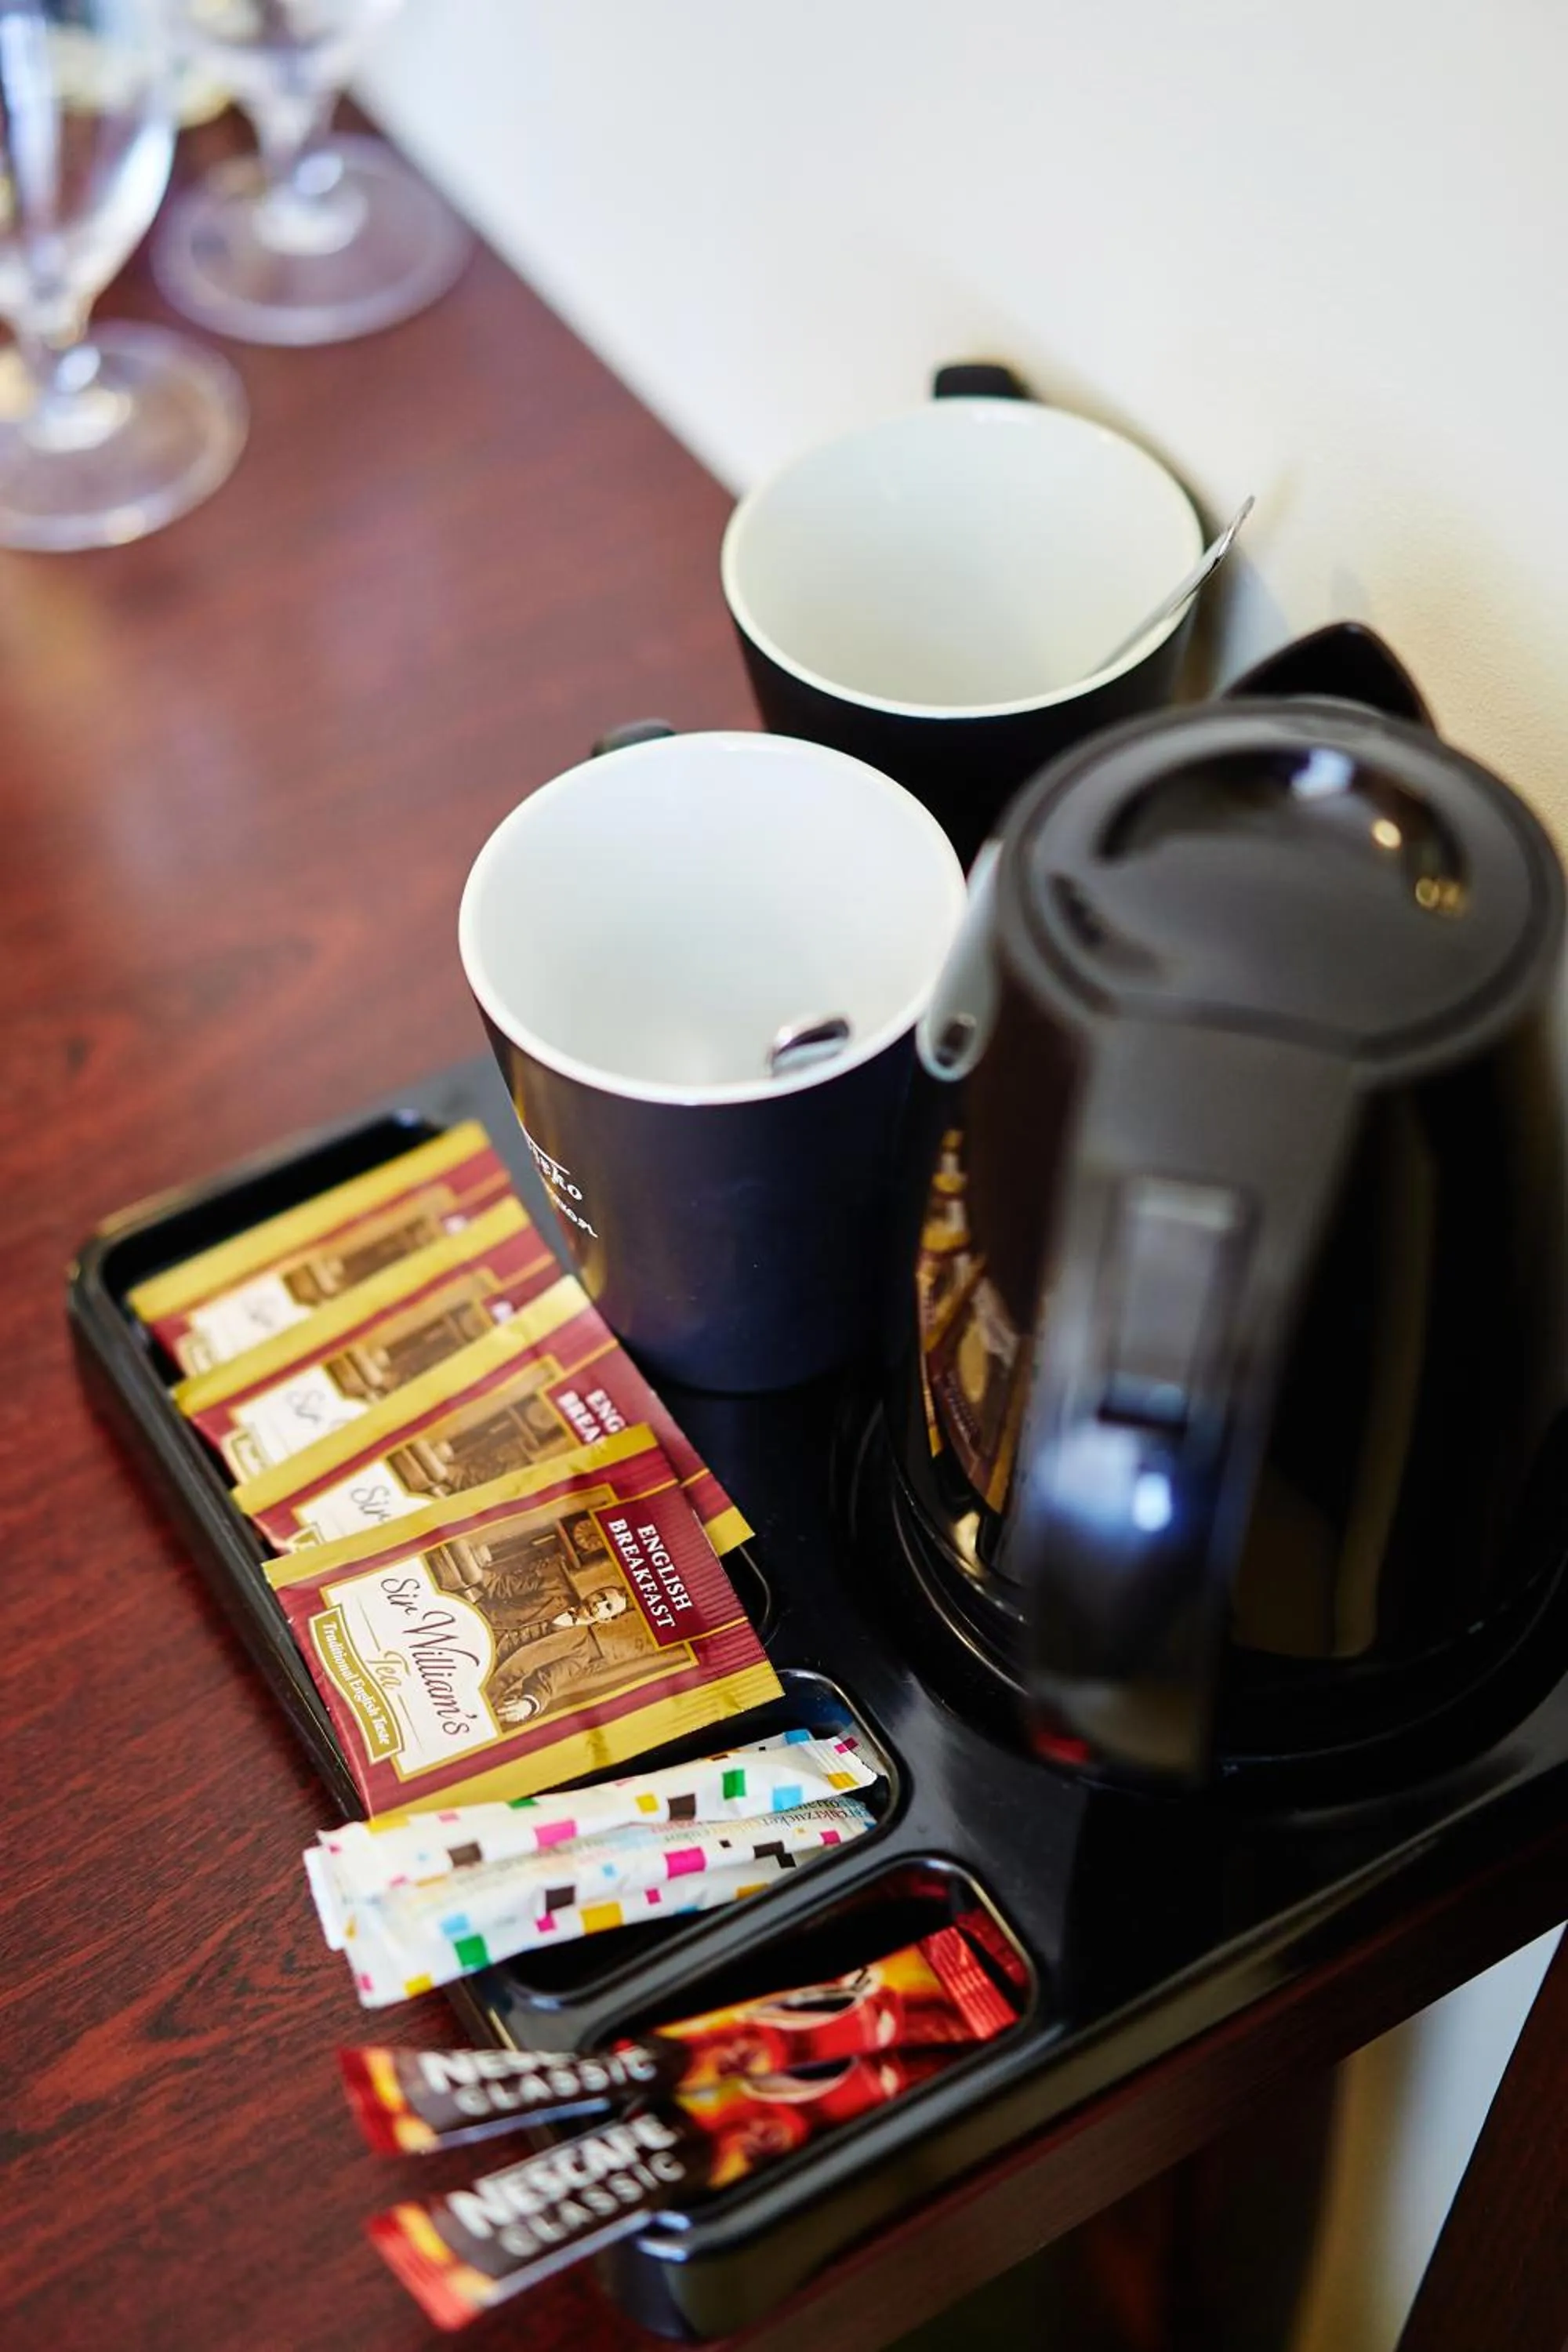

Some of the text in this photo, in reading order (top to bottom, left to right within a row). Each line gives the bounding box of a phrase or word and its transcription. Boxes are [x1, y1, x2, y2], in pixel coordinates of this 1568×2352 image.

[608, 1518, 676, 1628] BREAKFAST
[637, 1523, 693, 1611] ENGLISH
[322, 1621, 391, 1746] Traditional English Taste
[365, 1650, 411, 1691] Tea
[380, 1577, 481, 1736] Sir William's
[452, 2045, 658, 2116] CLASSIC
[499, 2151, 687, 2258] CLASSIC
